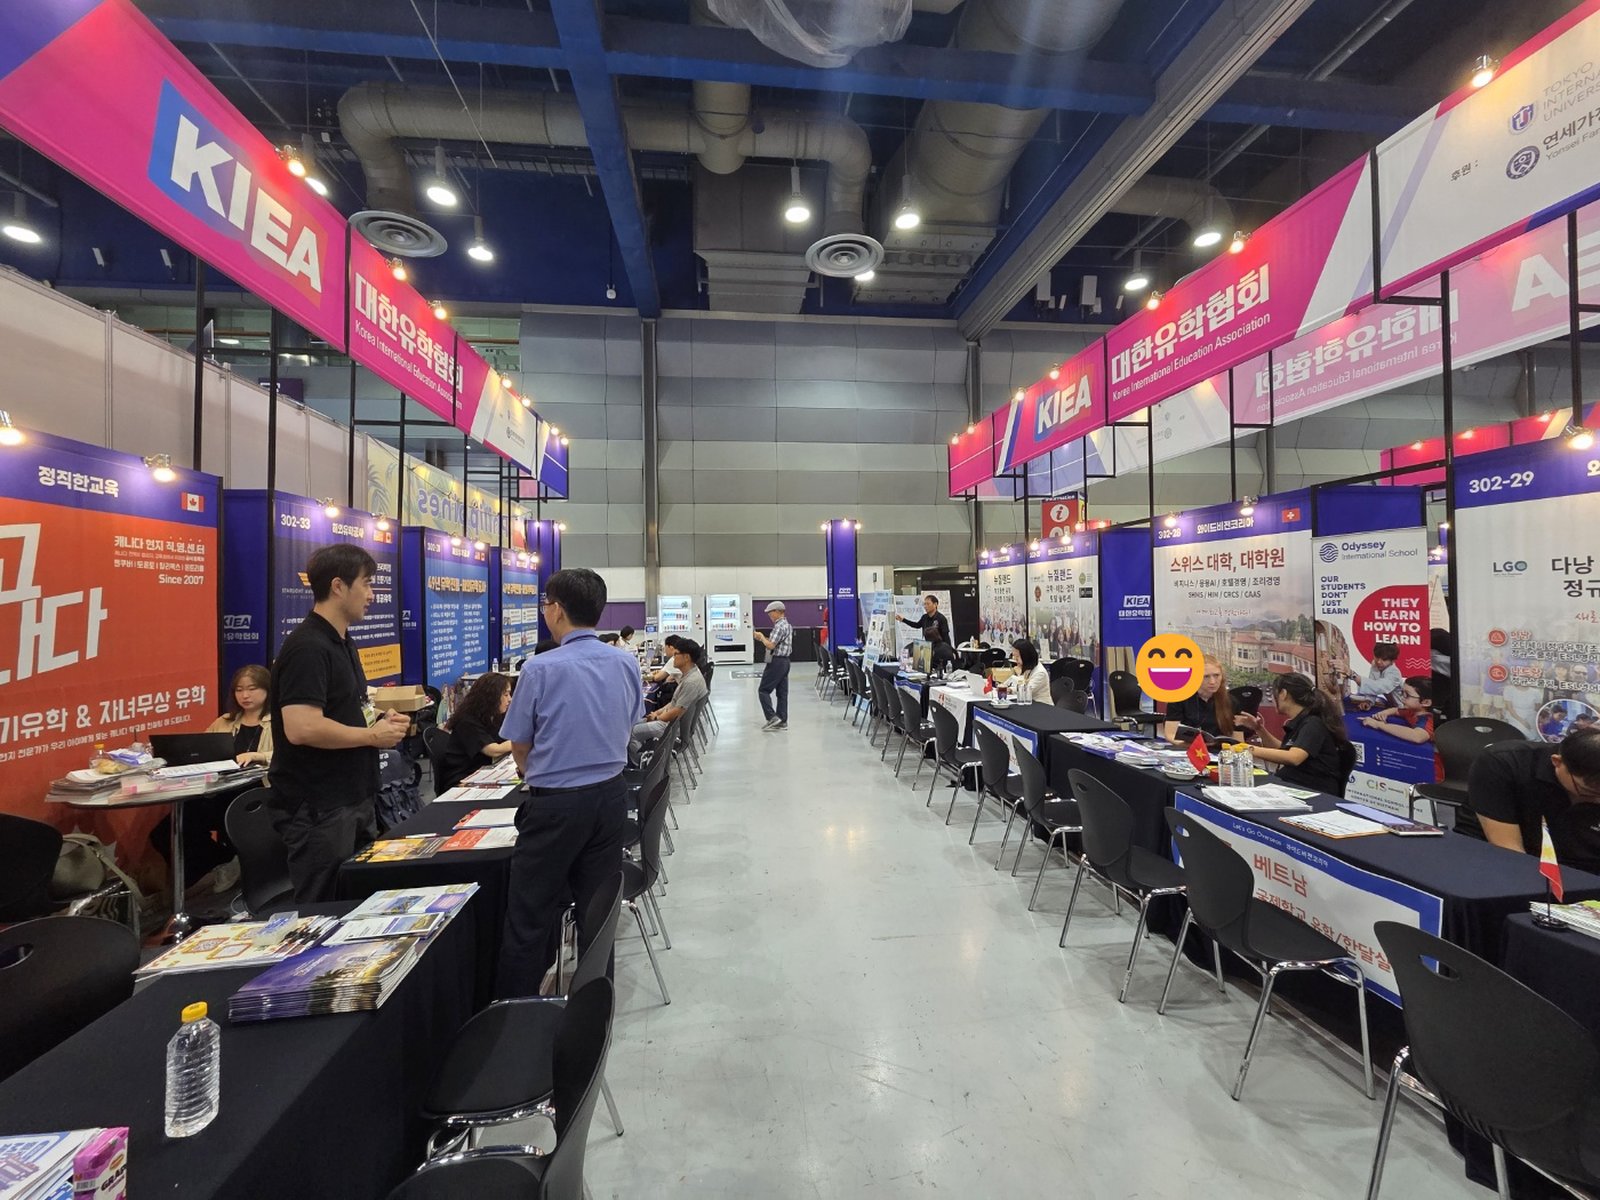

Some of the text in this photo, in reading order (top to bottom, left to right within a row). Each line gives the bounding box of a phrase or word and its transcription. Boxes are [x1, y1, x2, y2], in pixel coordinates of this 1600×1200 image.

[1543, 61, 1593, 96] TOKYO
[1546, 137, 1580, 161] Yonsei
[1450, 162, 1471, 181] 후원
[170, 114, 323, 293] KIEA
[1112, 263, 1269, 384] 대한유학협회
[355, 272, 463, 393] 대한유학협회
[355, 320, 376, 346] Korea
[376, 336, 413, 373] International
[1112, 313, 1270, 401] Korea International Education Association
[1037, 376, 1092, 434] KIEA
[38, 465, 119, 498] 정직한교육
[1468, 470, 1535, 494] 302-29
[280, 514, 311, 530] 302-33
[114, 535, 144, 550] 캐나다
[1341, 541, 1386, 552] Odyssey
[1170, 547, 1285, 573] 스위스 대학, 대학원
[1342, 551, 1387, 560] International
[1389, 548, 1418, 558] School
[1493, 560, 1528, 573] LGO
[1551, 555, 1594, 575] 다낭
[158, 573, 204, 585] Since 2007
[1321, 575, 1339, 583] OUR
[1126, 597, 1149, 606] KIEA
[1382, 598, 1419, 607] THEY
[1374, 610, 1420, 620] LEARN
[1364, 621, 1421, 633] HOW TO
[1375, 633, 1421, 645] LEARN
[76, 704, 91, 729] &
[100, 692, 171, 724] 자녀무상
[176, 685, 206, 709] 유학
[50, 741, 66, 750] 우리
[1367, 779, 1387, 793] CIS
[1232, 822, 1246, 832] Let's
[1246, 827, 1256, 836] Go
[1254, 853, 1308, 898] 베트남
